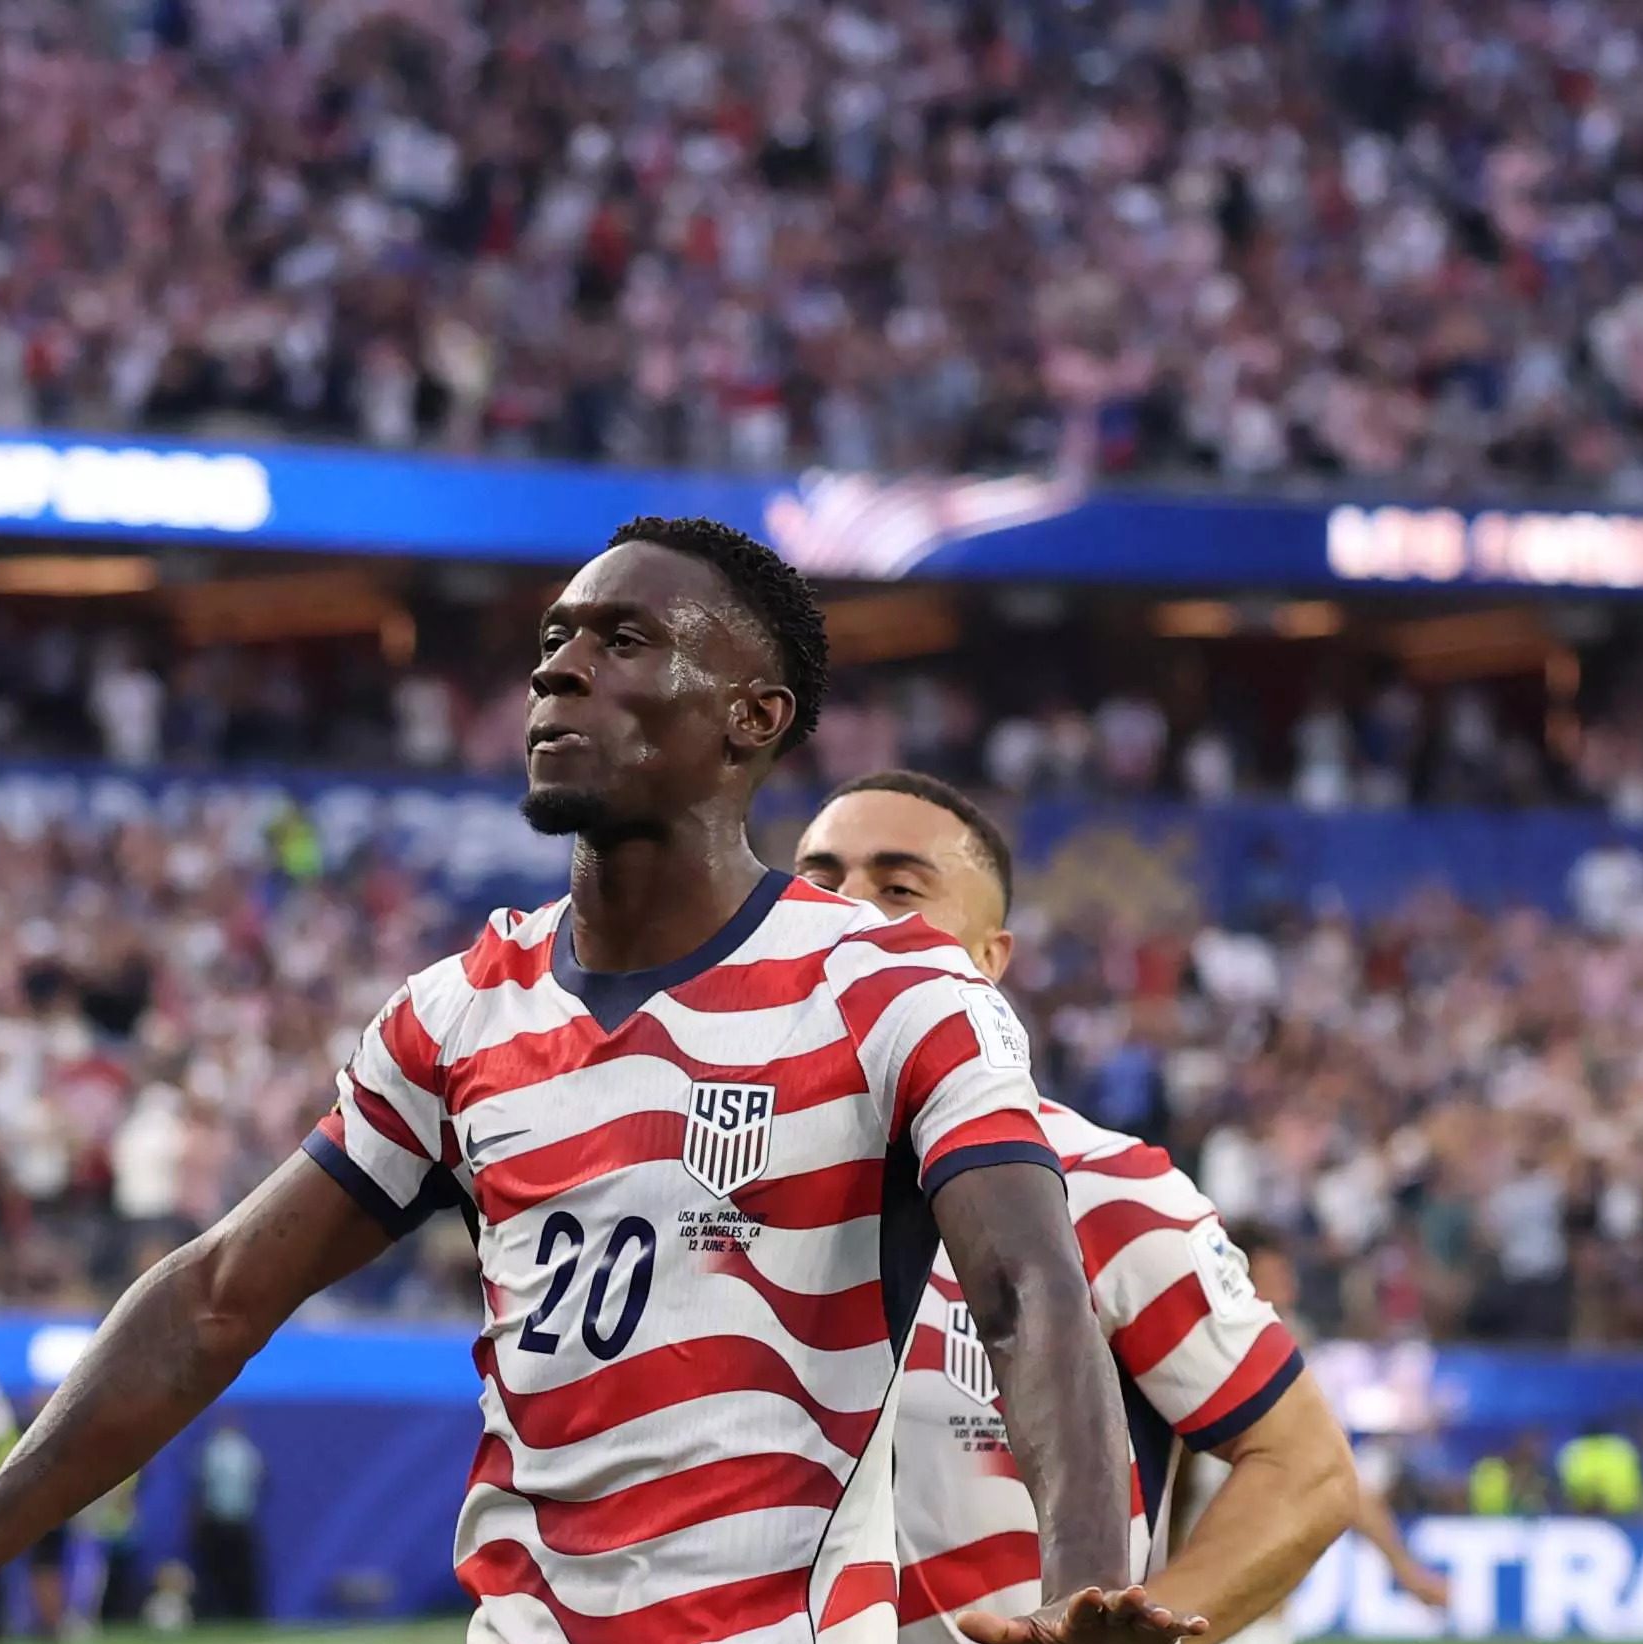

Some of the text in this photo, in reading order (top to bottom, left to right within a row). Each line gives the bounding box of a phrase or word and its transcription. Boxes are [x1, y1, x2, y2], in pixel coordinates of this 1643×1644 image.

[696, 1088, 768, 1131] USA
[678, 1211, 695, 1223] USA
[699, 1212, 713, 1223] VS.
[680, 1225, 761, 1239] LOS ANGELES, CA
[688, 1239, 698, 1251] 12
[701, 1239, 726, 1252] JUNE
[518, 1211, 656, 1361] 20
